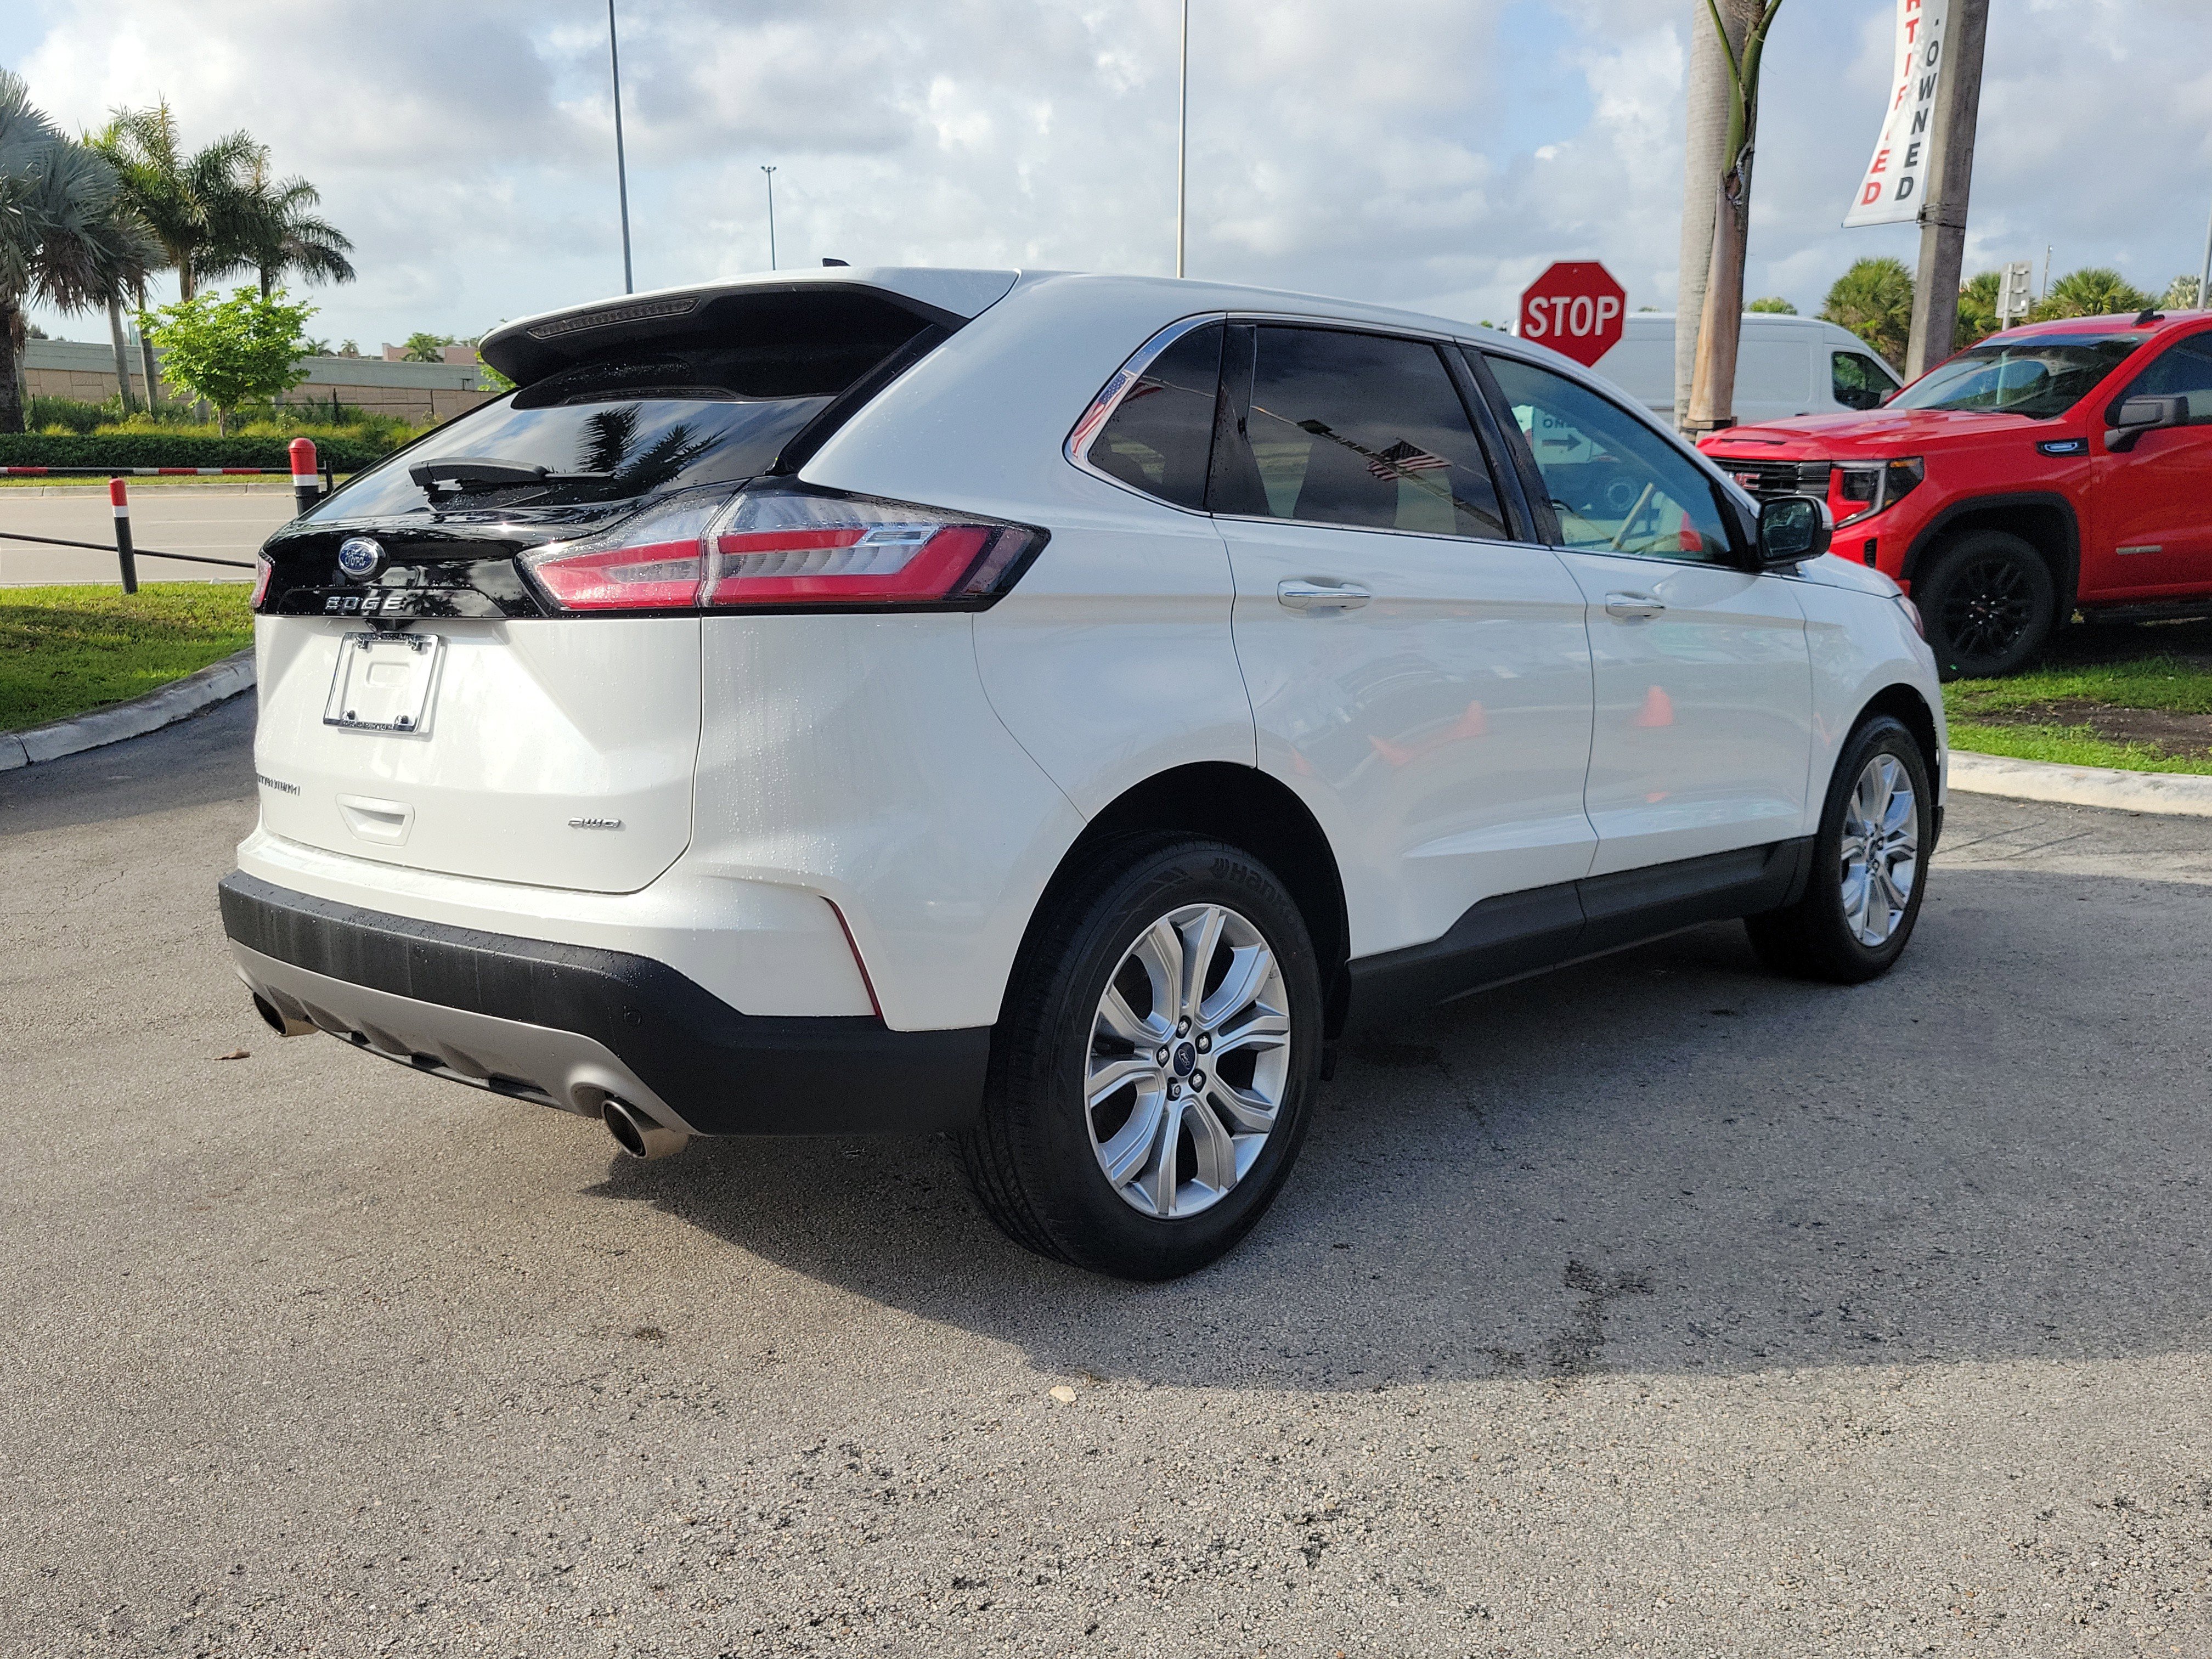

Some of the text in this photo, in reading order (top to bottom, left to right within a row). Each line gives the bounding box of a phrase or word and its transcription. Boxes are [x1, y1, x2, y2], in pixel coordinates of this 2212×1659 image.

[1525, 295, 1620, 337] STOP
[344, 548, 366, 567] Ford
[325, 596, 404, 610] EDGE
